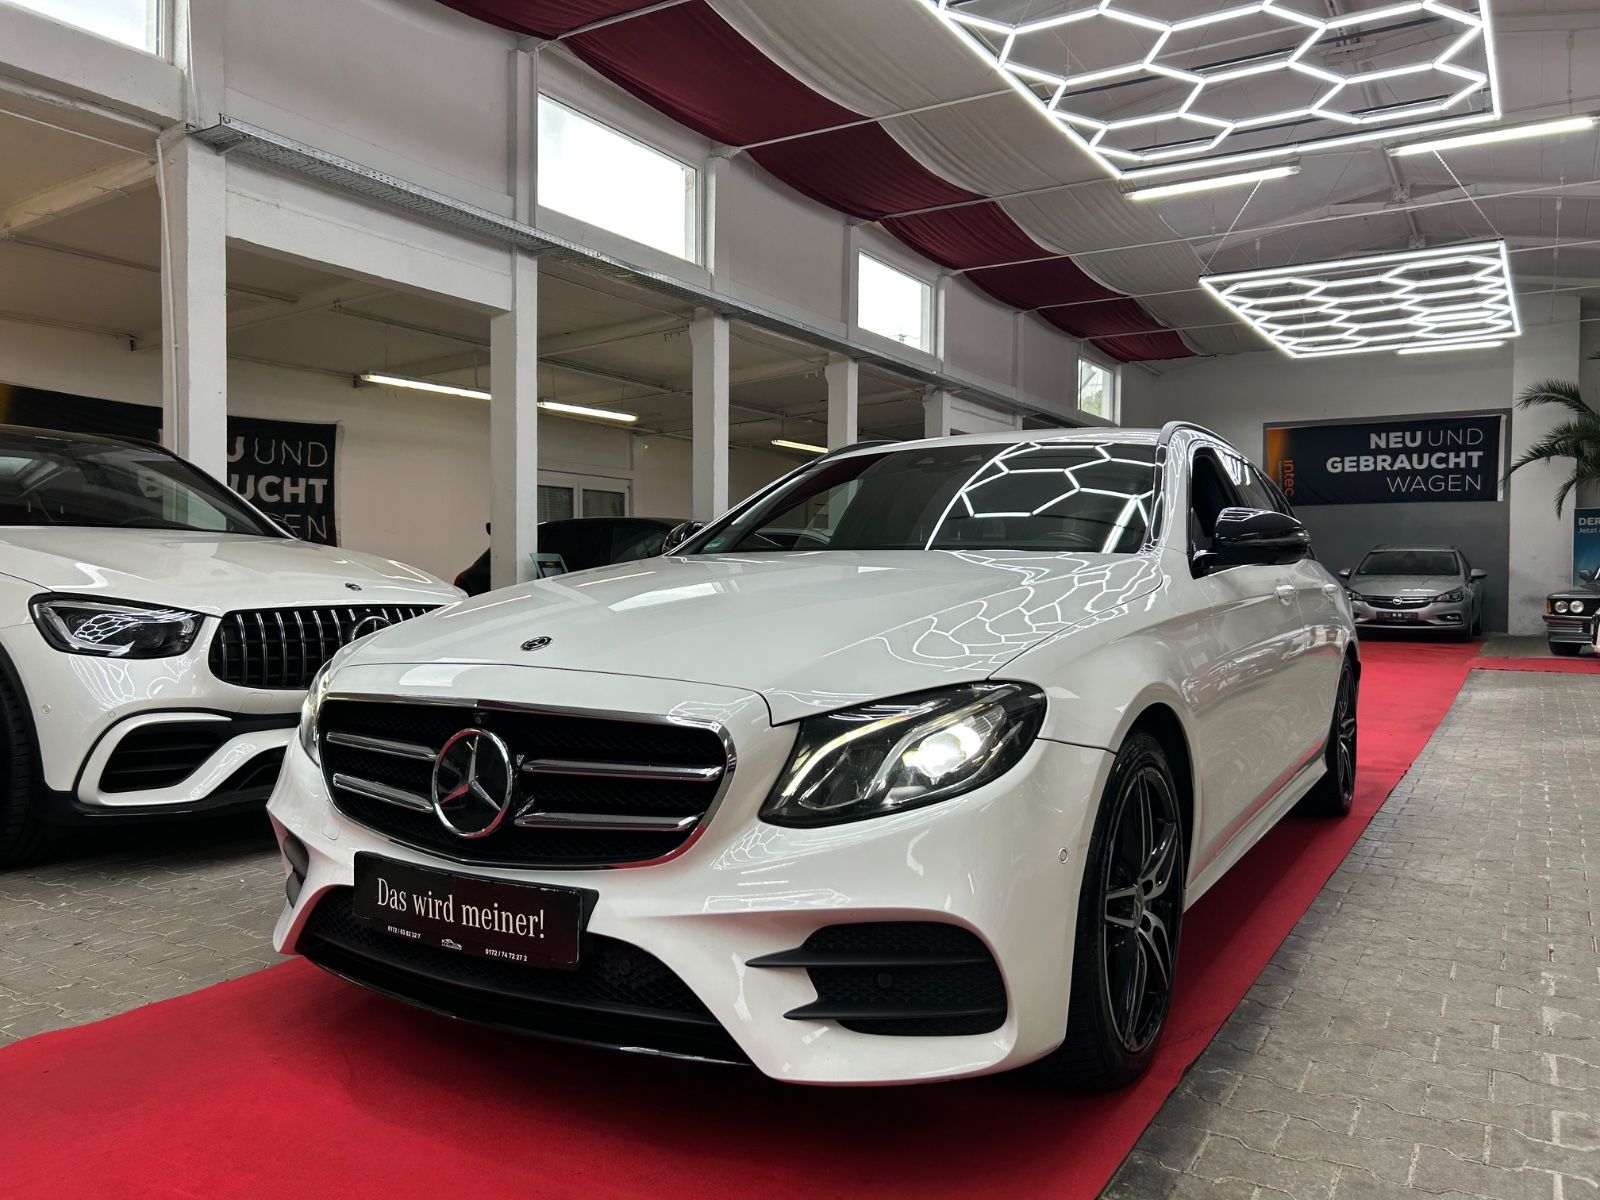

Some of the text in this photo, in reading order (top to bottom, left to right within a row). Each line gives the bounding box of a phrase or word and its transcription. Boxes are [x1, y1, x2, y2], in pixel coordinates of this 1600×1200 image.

[1370, 428, 1483, 449] NEU UND
[254, 438, 328, 467] UND
[1326, 451, 1483, 473] GEBRAUCHT
[1386, 474, 1481, 493] WAGEN
[377, 877, 545, 939] Das wird meiner!
